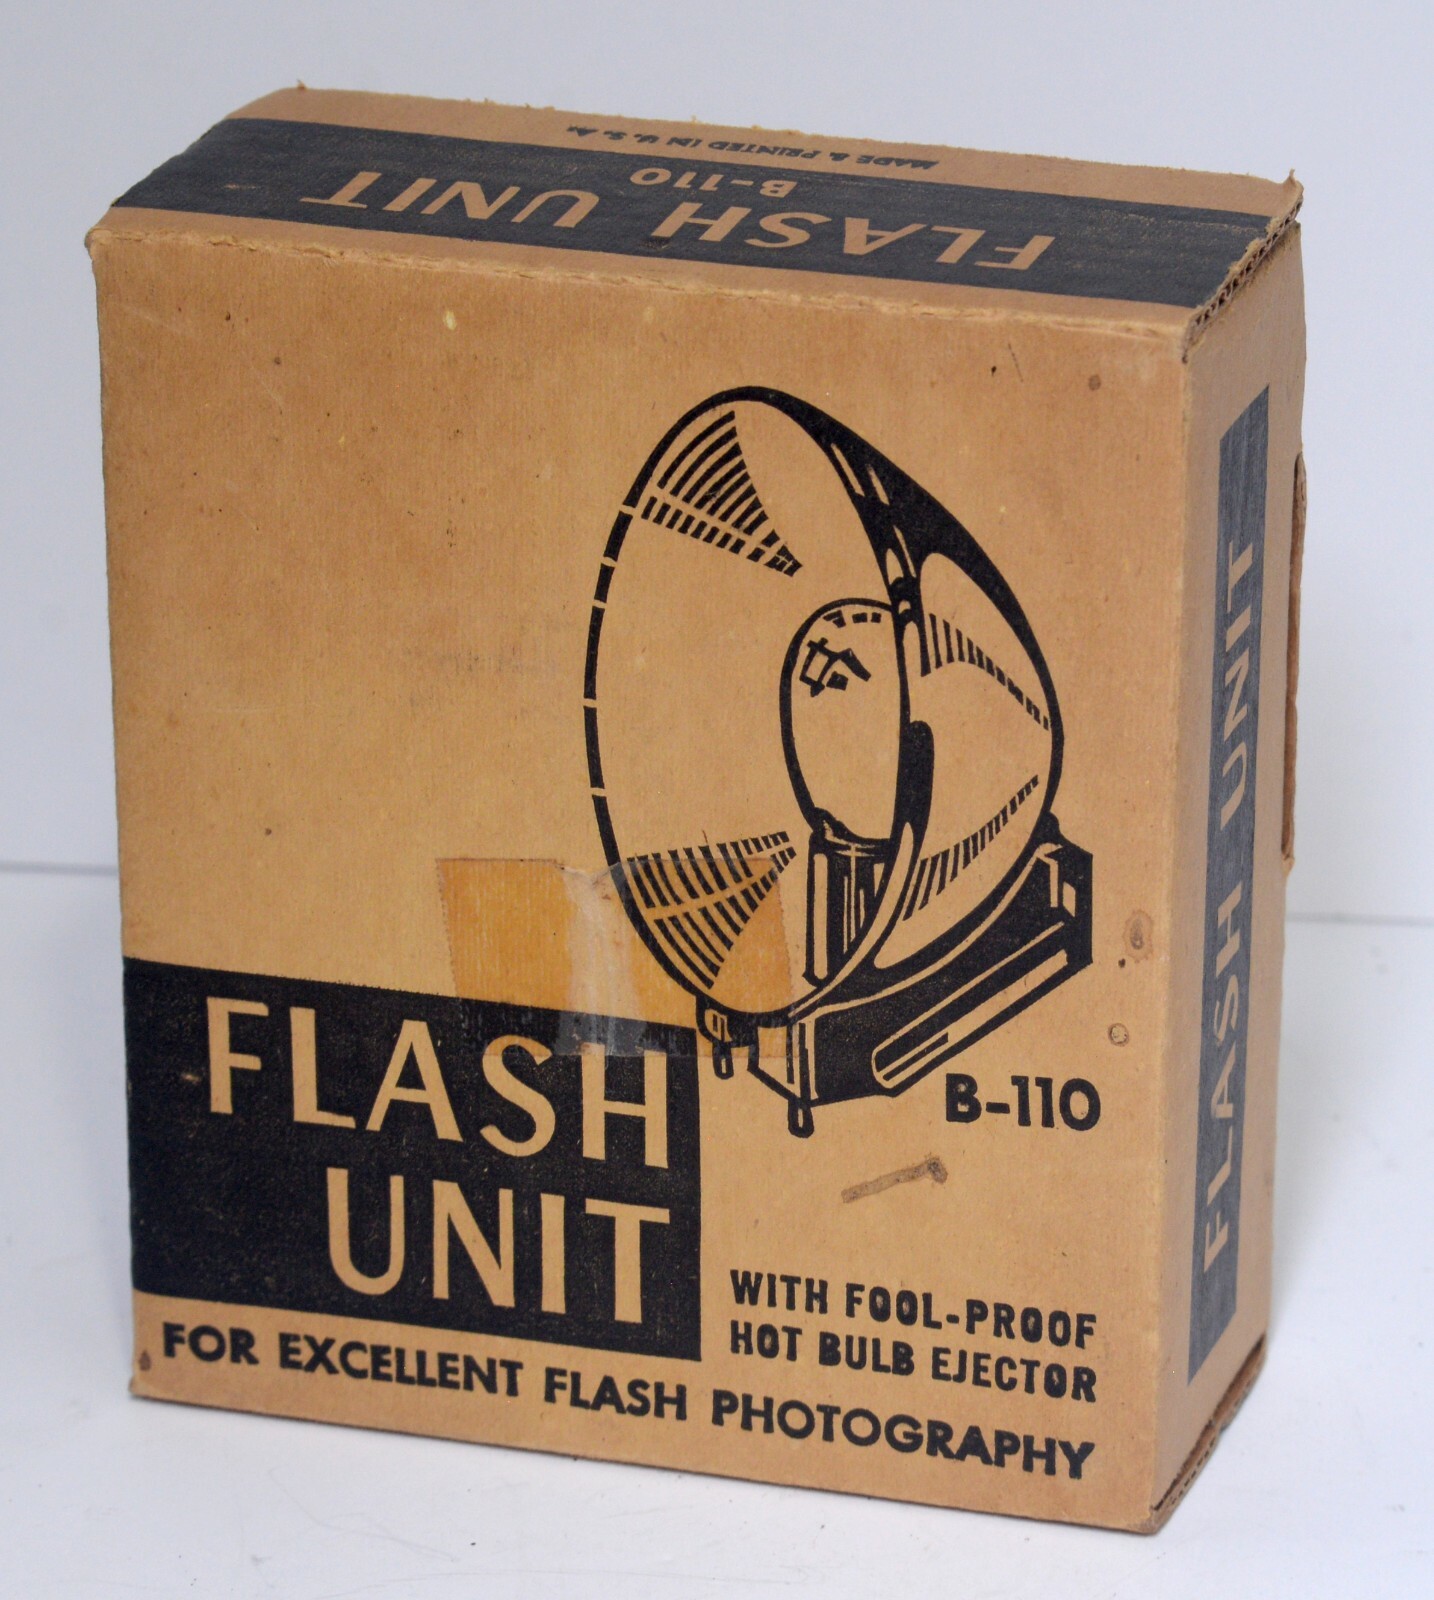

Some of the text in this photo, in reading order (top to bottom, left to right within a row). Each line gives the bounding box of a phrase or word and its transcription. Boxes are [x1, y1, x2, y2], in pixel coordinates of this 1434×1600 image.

[666, 135, 703, 148] IN
[708, 140, 823, 160] PRINTED
[828, 151, 850, 162] &
[856, 154, 941, 171] MADE
[299, 169, 1057, 271] FLASH UNIT
[629, 167, 802, 198] B-110
[1203, 539, 1253, 1274] FLASH UNIT
[207, 996, 669, 1170] FLASH
[945, 1072, 1102, 1132] B-110
[326, 1167, 670, 1325] UNIT
[730, 1269, 1097, 1350] WITH FOOL-PROOF
[162, 1321, 1096, 1480] FOR EXCELLENT FLASH PHOTOGRAPHY
[730, 1319, 1097, 1403] HOT BULB EJECTOR
